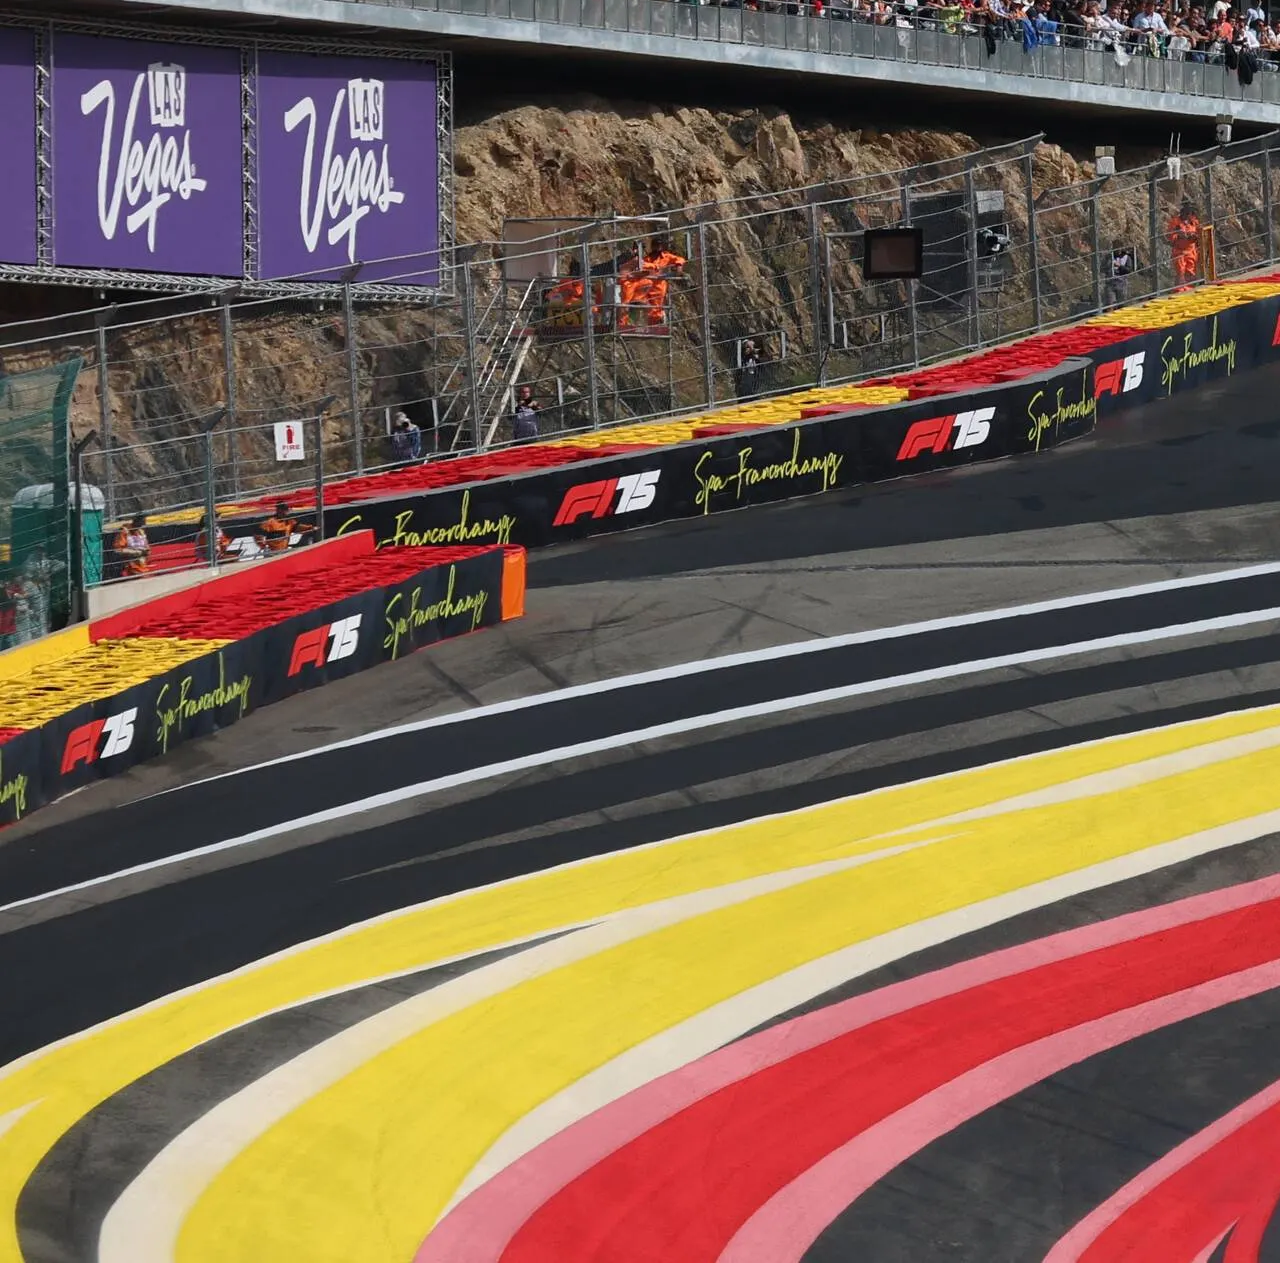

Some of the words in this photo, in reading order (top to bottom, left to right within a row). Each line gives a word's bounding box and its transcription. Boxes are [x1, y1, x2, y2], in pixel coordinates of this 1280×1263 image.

[149, 68, 184, 121] LAS
[352, 84, 382, 133] LAS
[81, 73, 207, 253] Vegas
[284, 88, 404, 264] Vegas
